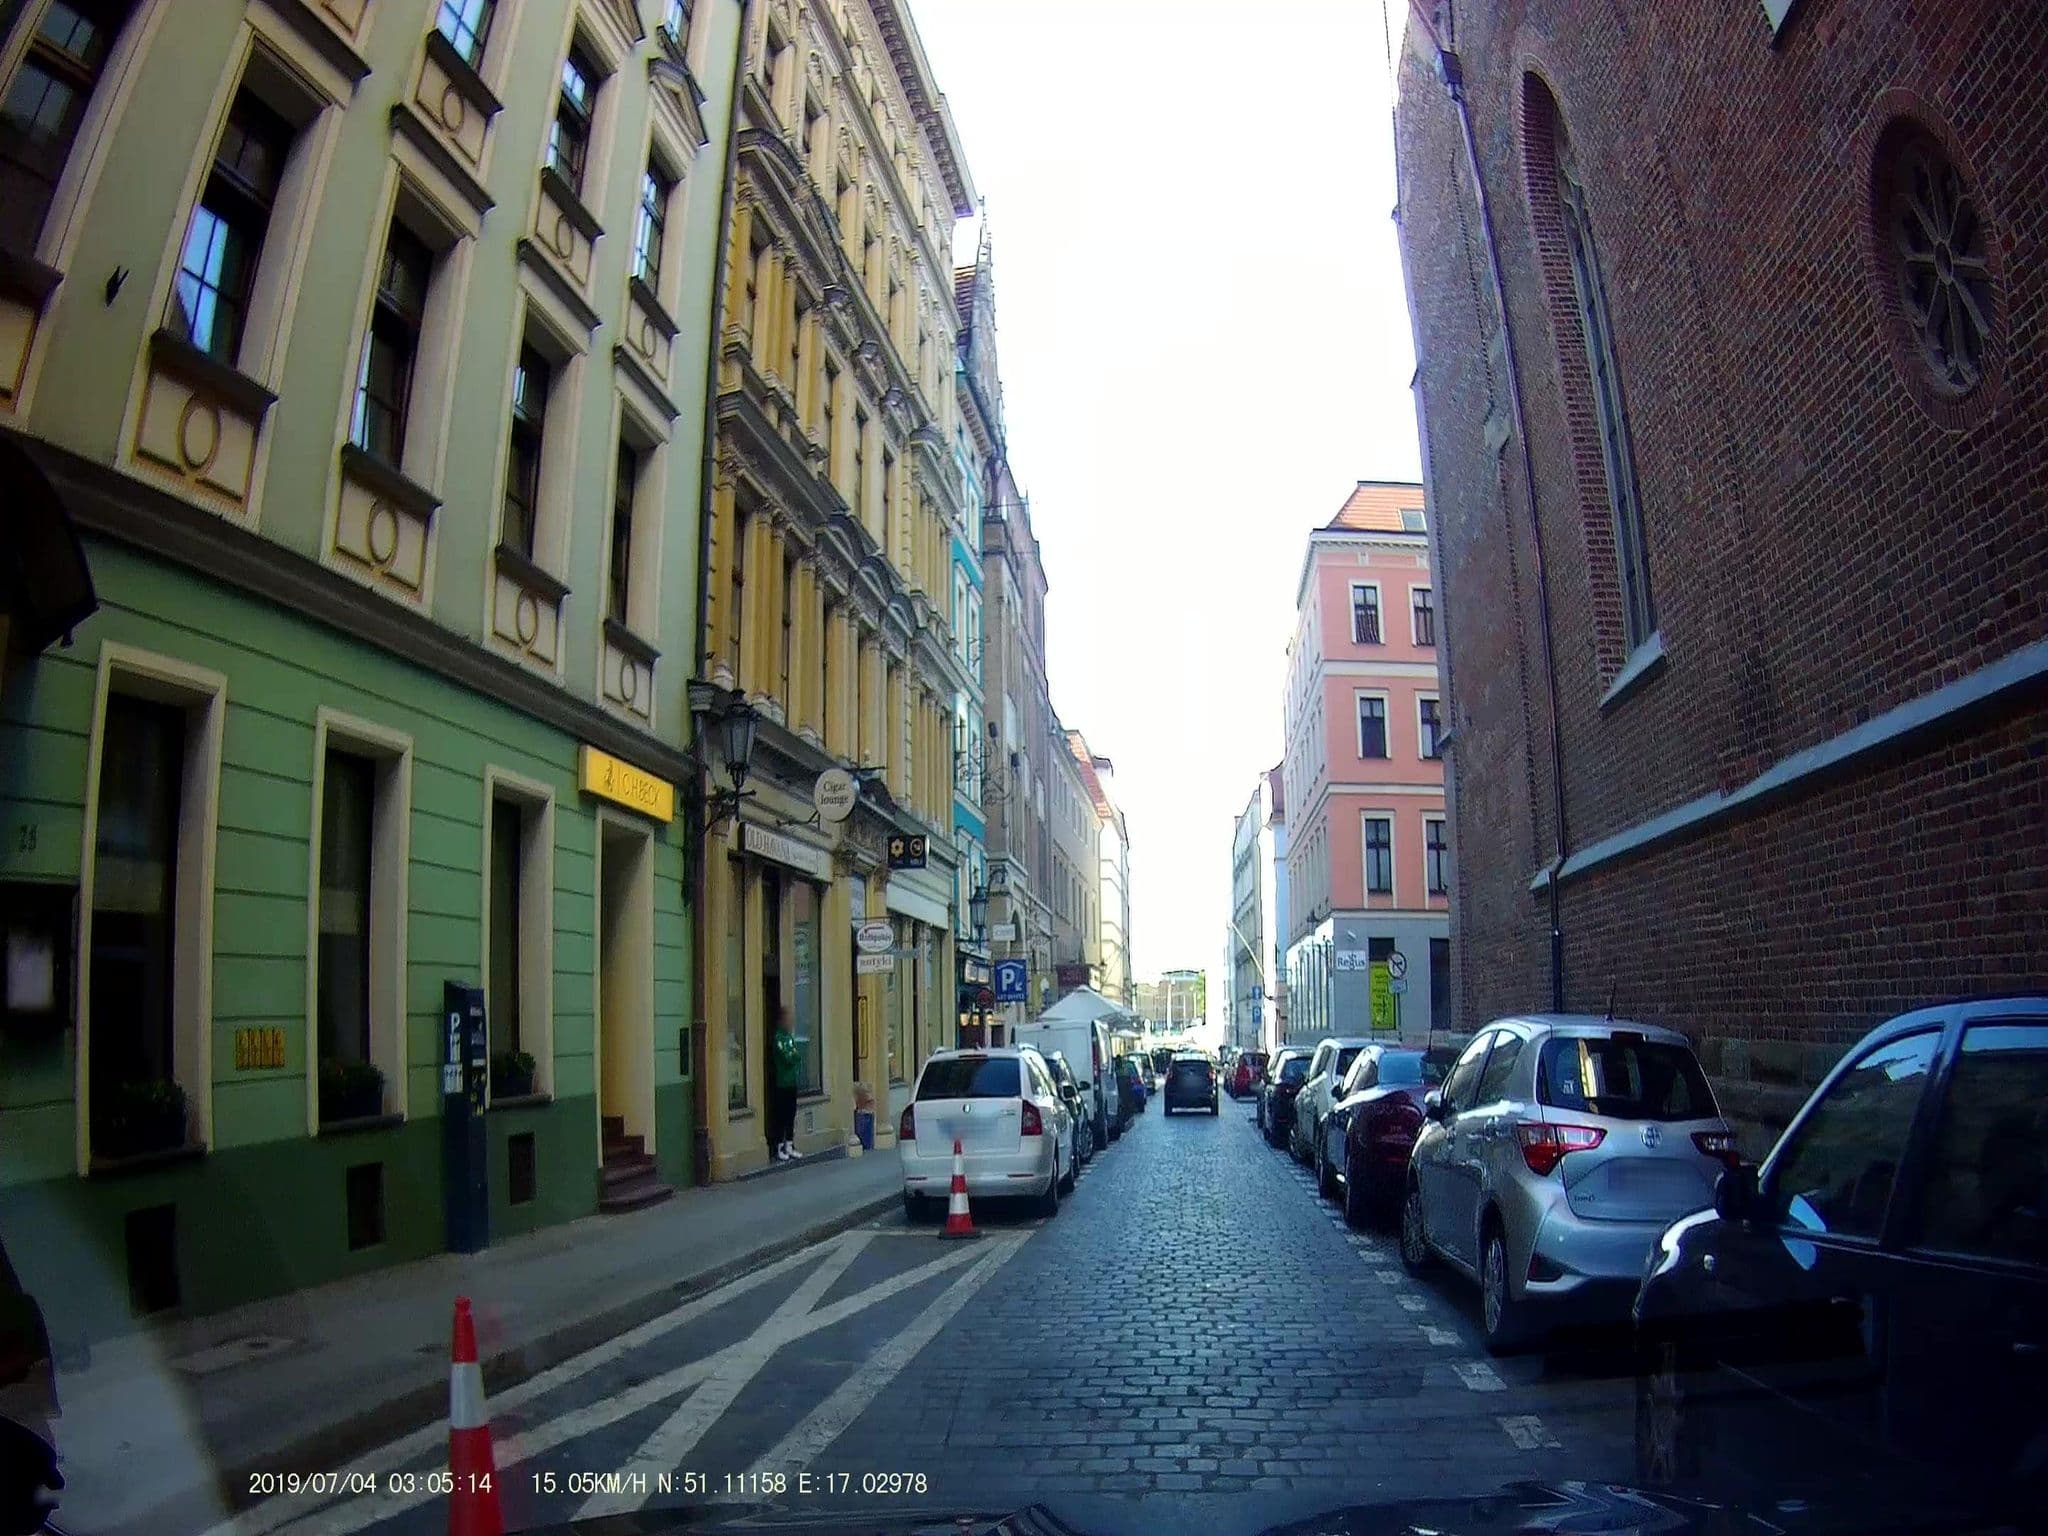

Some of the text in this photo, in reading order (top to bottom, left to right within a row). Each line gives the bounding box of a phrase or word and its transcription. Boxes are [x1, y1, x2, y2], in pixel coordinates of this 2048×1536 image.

[823, 780, 846, 793] Cigar
[820, 795, 849, 807] lounge
[1337, 957, 1365, 971] Regus
[1001, 968, 1015, 992] P
